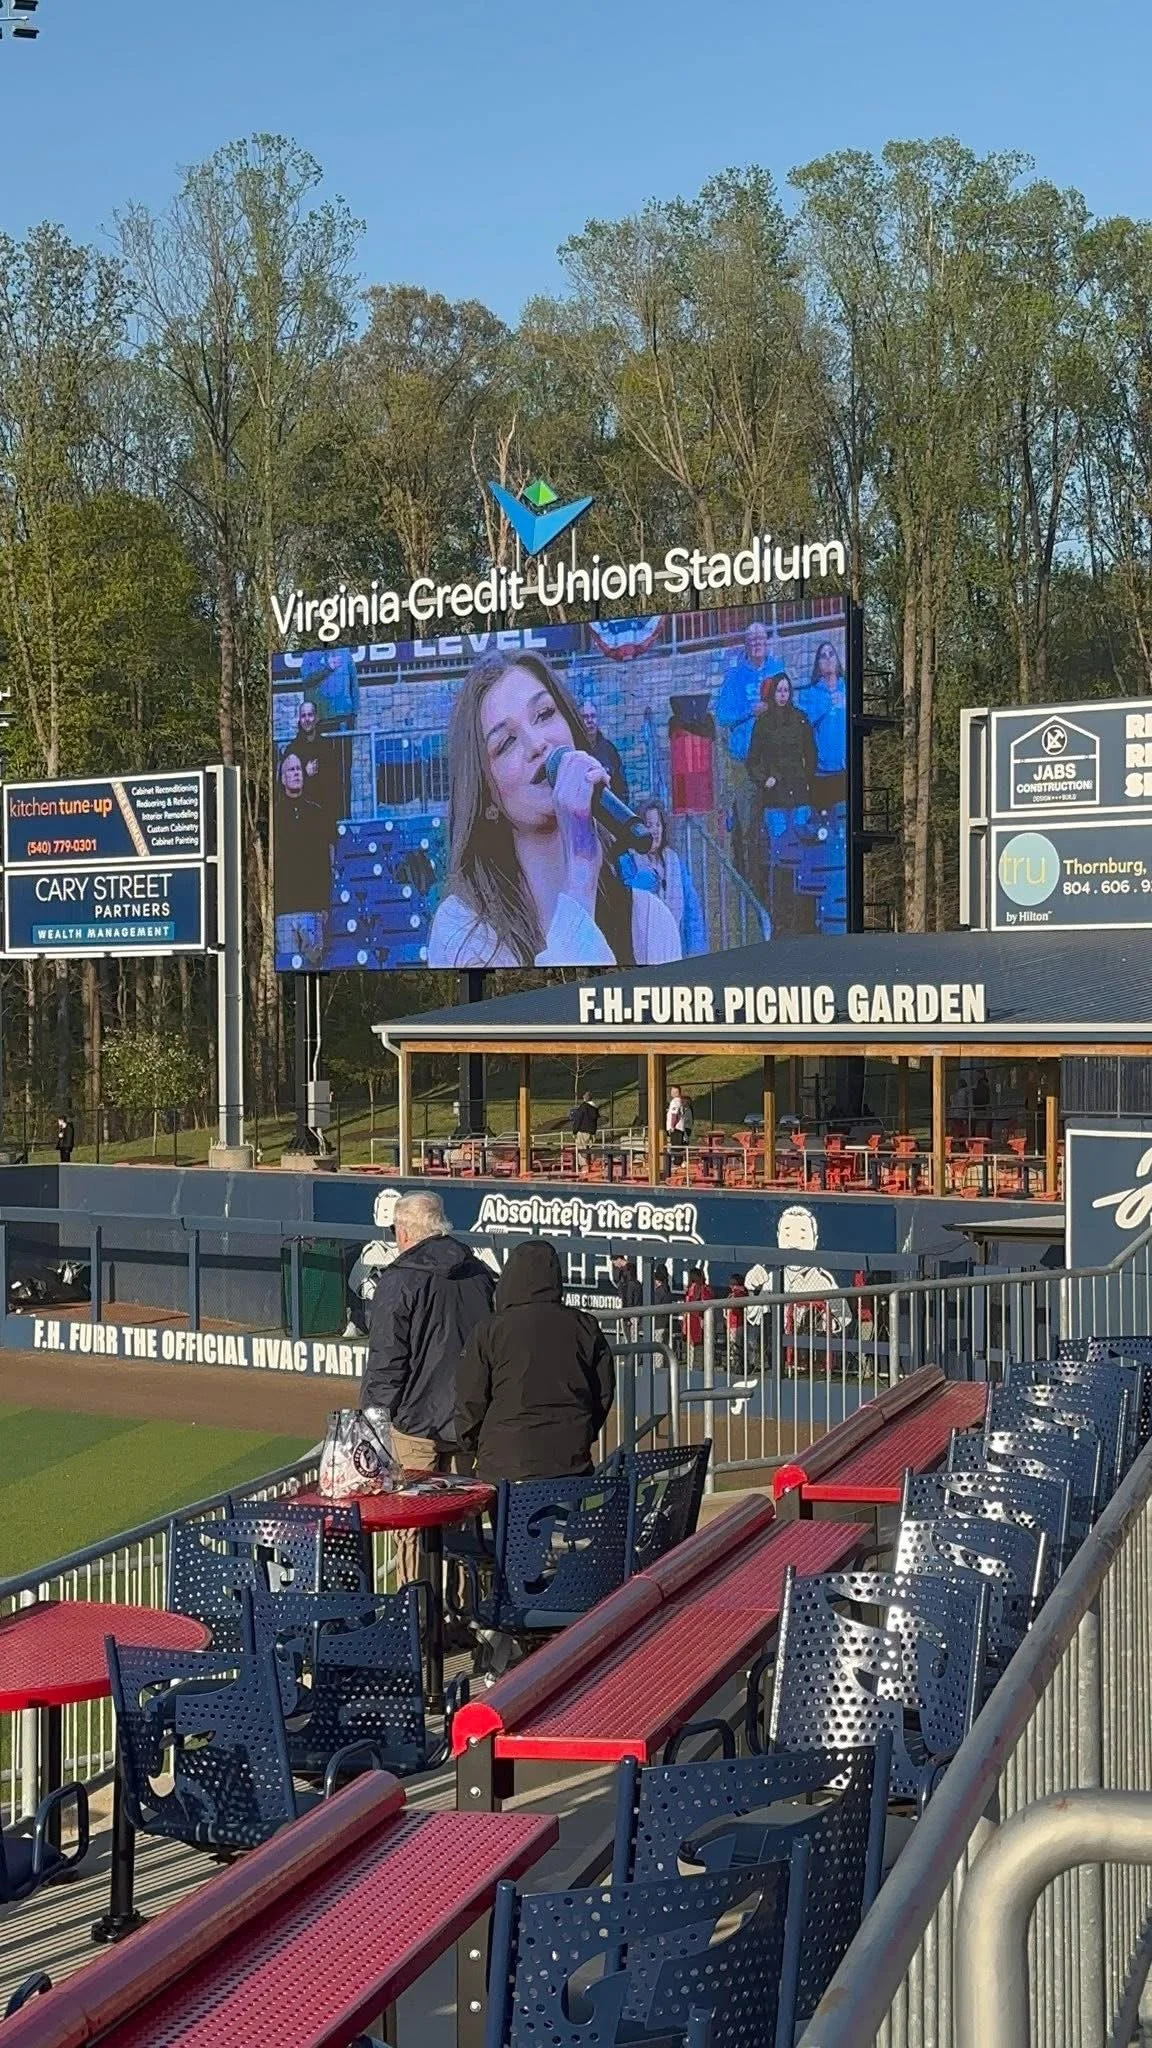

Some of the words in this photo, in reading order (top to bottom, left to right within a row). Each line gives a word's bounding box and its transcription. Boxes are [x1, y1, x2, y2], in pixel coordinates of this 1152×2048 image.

[270, 580, 400, 642] Virginia
[408, 566, 524, 621] Credit
[538, 554, 652, 606] Union
[664, 534, 845, 592] Stadium
[1033, 763, 1076, 781] JABS
[131, 786, 154, 796] Cabinet
[1016, 780, 1091, 793] CONSTRUCTION
[9, 796, 57, 817] kitchen
[59, 797, 112, 818] tune-up
[141, 812, 163, 821] Interior
[164, 809, 199, 820] Remodeling
[147, 824, 169, 834] Custom
[170, 822, 199, 833] Cabinetry
[27, 840, 52, 856] (540)
[53, 838, 97, 853] 779-0301
[151, 837, 174, 846] Cabinet
[175, 836, 199, 846] Painting
[1000, 851, 1046, 886] tru
[1063, 856, 1147, 877] Thornburg,
[35, 877, 89, 901] CARY
[93, 873, 173, 900] STREET
[95, 903, 170, 918] PARTNERS
[1006, 911, 1017, 924] by
[1019, 911, 1049, 921] Hilton
[38, 929, 82, 940] WEALTH
[87, 926, 169, 939] MANAGEMENT
[724, 986, 835, 1023] PICNIC
[848, 984, 985, 1023] GARDEN
[482, 1197, 593, 1232] Absolutely
[598, 1202, 633, 1229] the
[638, 1206, 692, 1232] Best!
[565, 1294, 580, 1306] AIR
[582, 1294, 622, 1309] CONDITIO
[34, 1320, 65, 1350] F.H.
[69, 1323, 118, 1353] FURR
[123, 1326, 157, 1358] THE
[162, 1331, 248, 1366] OFFICIAL
[252, 1337, 307, 1372] HVAC
[313, 1342, 369, 1376] PART
